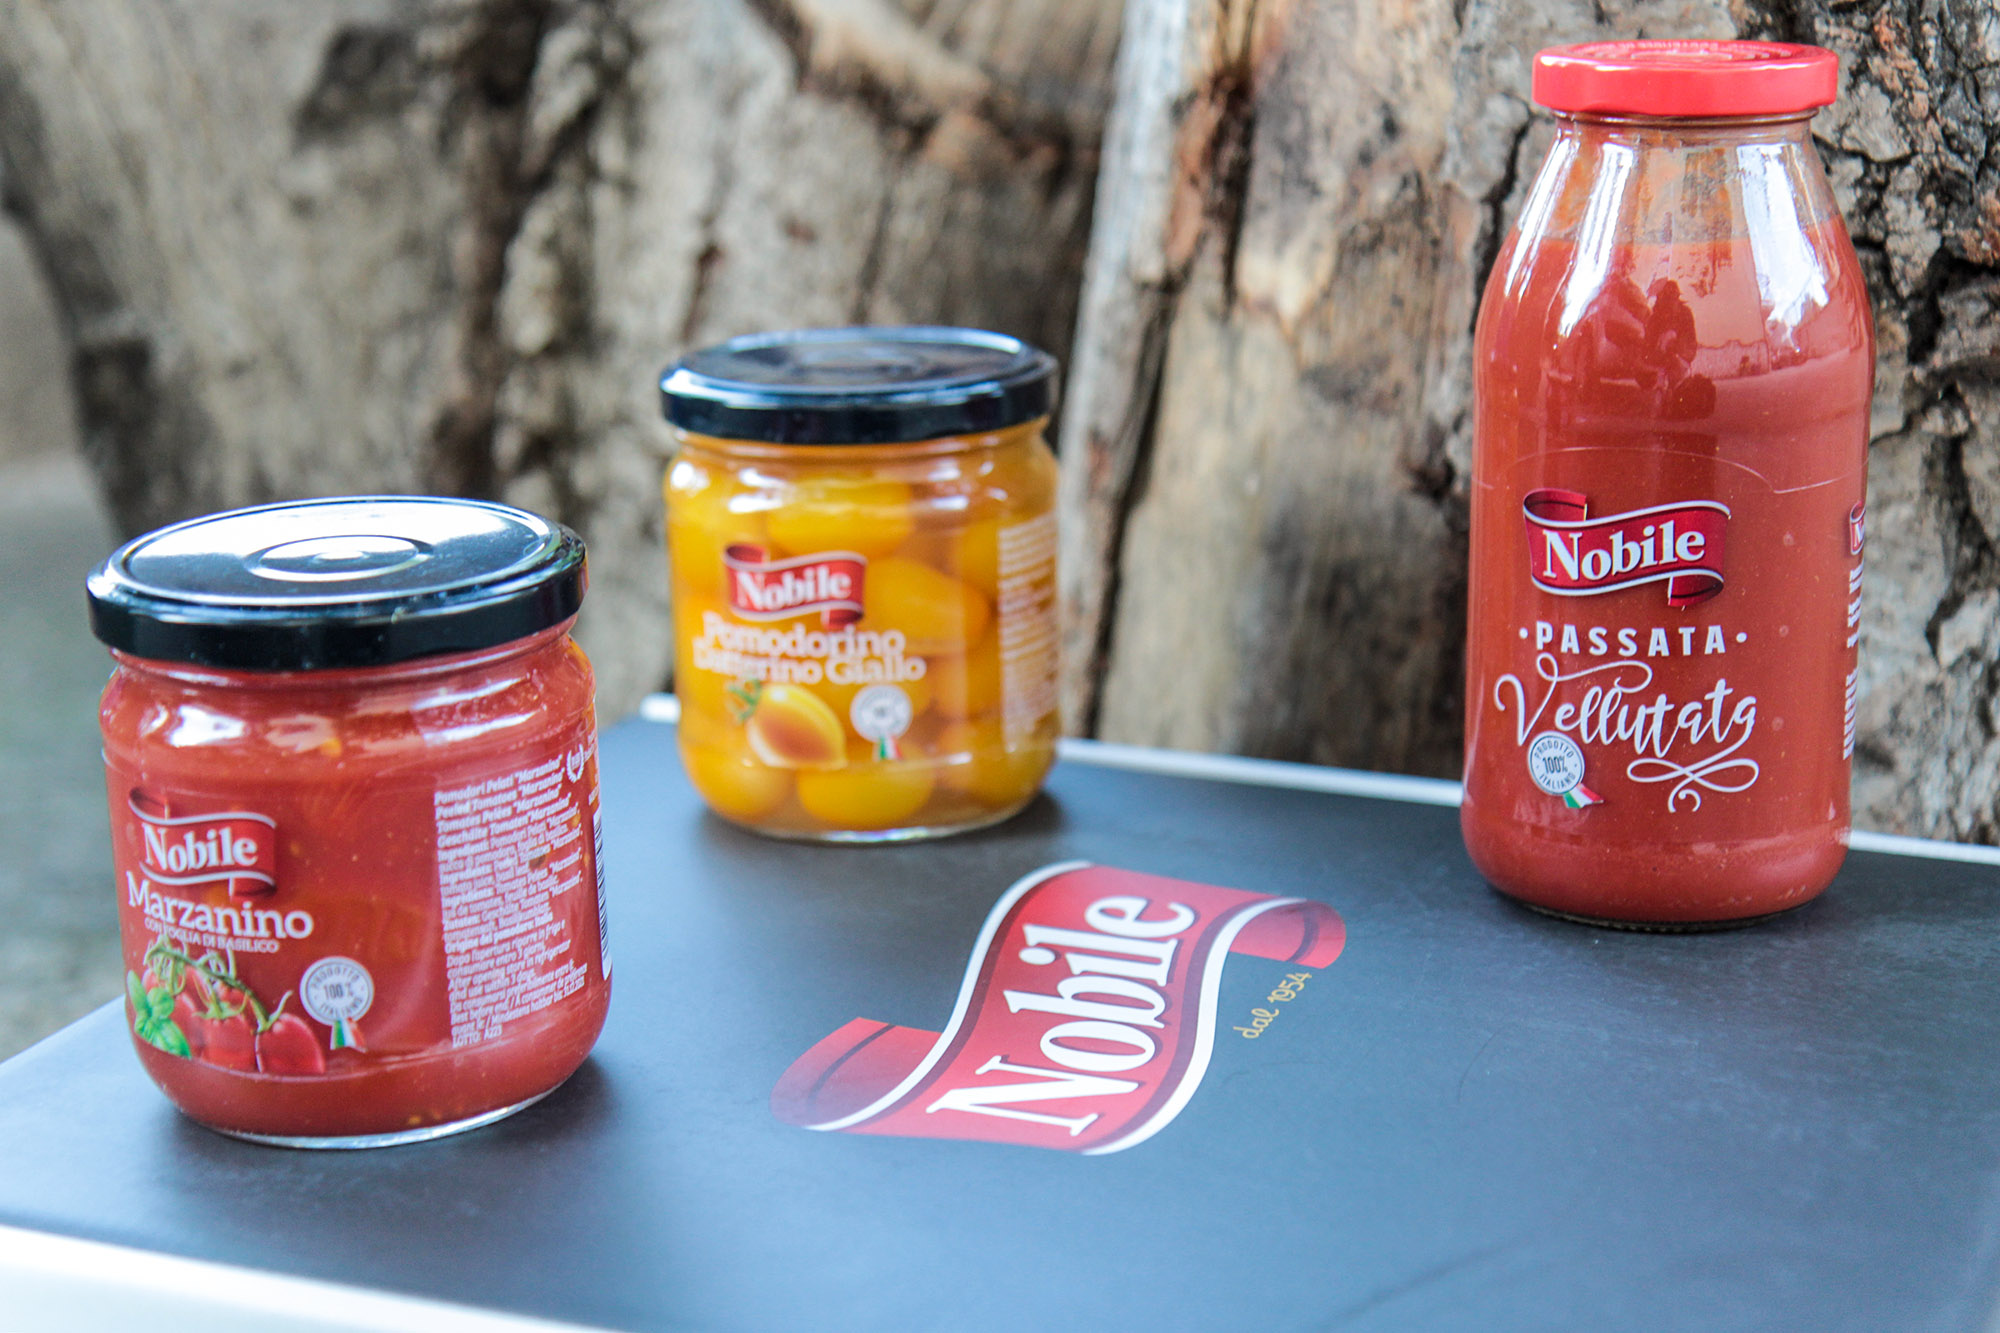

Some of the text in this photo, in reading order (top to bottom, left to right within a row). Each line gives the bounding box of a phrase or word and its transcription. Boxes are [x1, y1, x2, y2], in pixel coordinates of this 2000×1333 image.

[1543, 520, 1706, 582] Nobile
[736, 565, 853, 611] Nobile
[702, 611, 907, 658] Pomodorino
[1536, 620, 1727, 657] PASSATA
[824, 652, 928, 685] Giallo
[1494, 653, 1760, 812] Vellutata
[1534, 740, 1575, 759] PRODOTTO
[1540, 772, 1576, 790] ITALIANO
[1542, 755, 1569, 774] 100%
[142, 821, 258, 873] Nobile
[126, 870, 315, 940] Marzanino
[201, 934, 217, 949] DI
[925, 894, 1198, 1137] Nobile
[1232, 972, 1314, 1040] dal 1954
